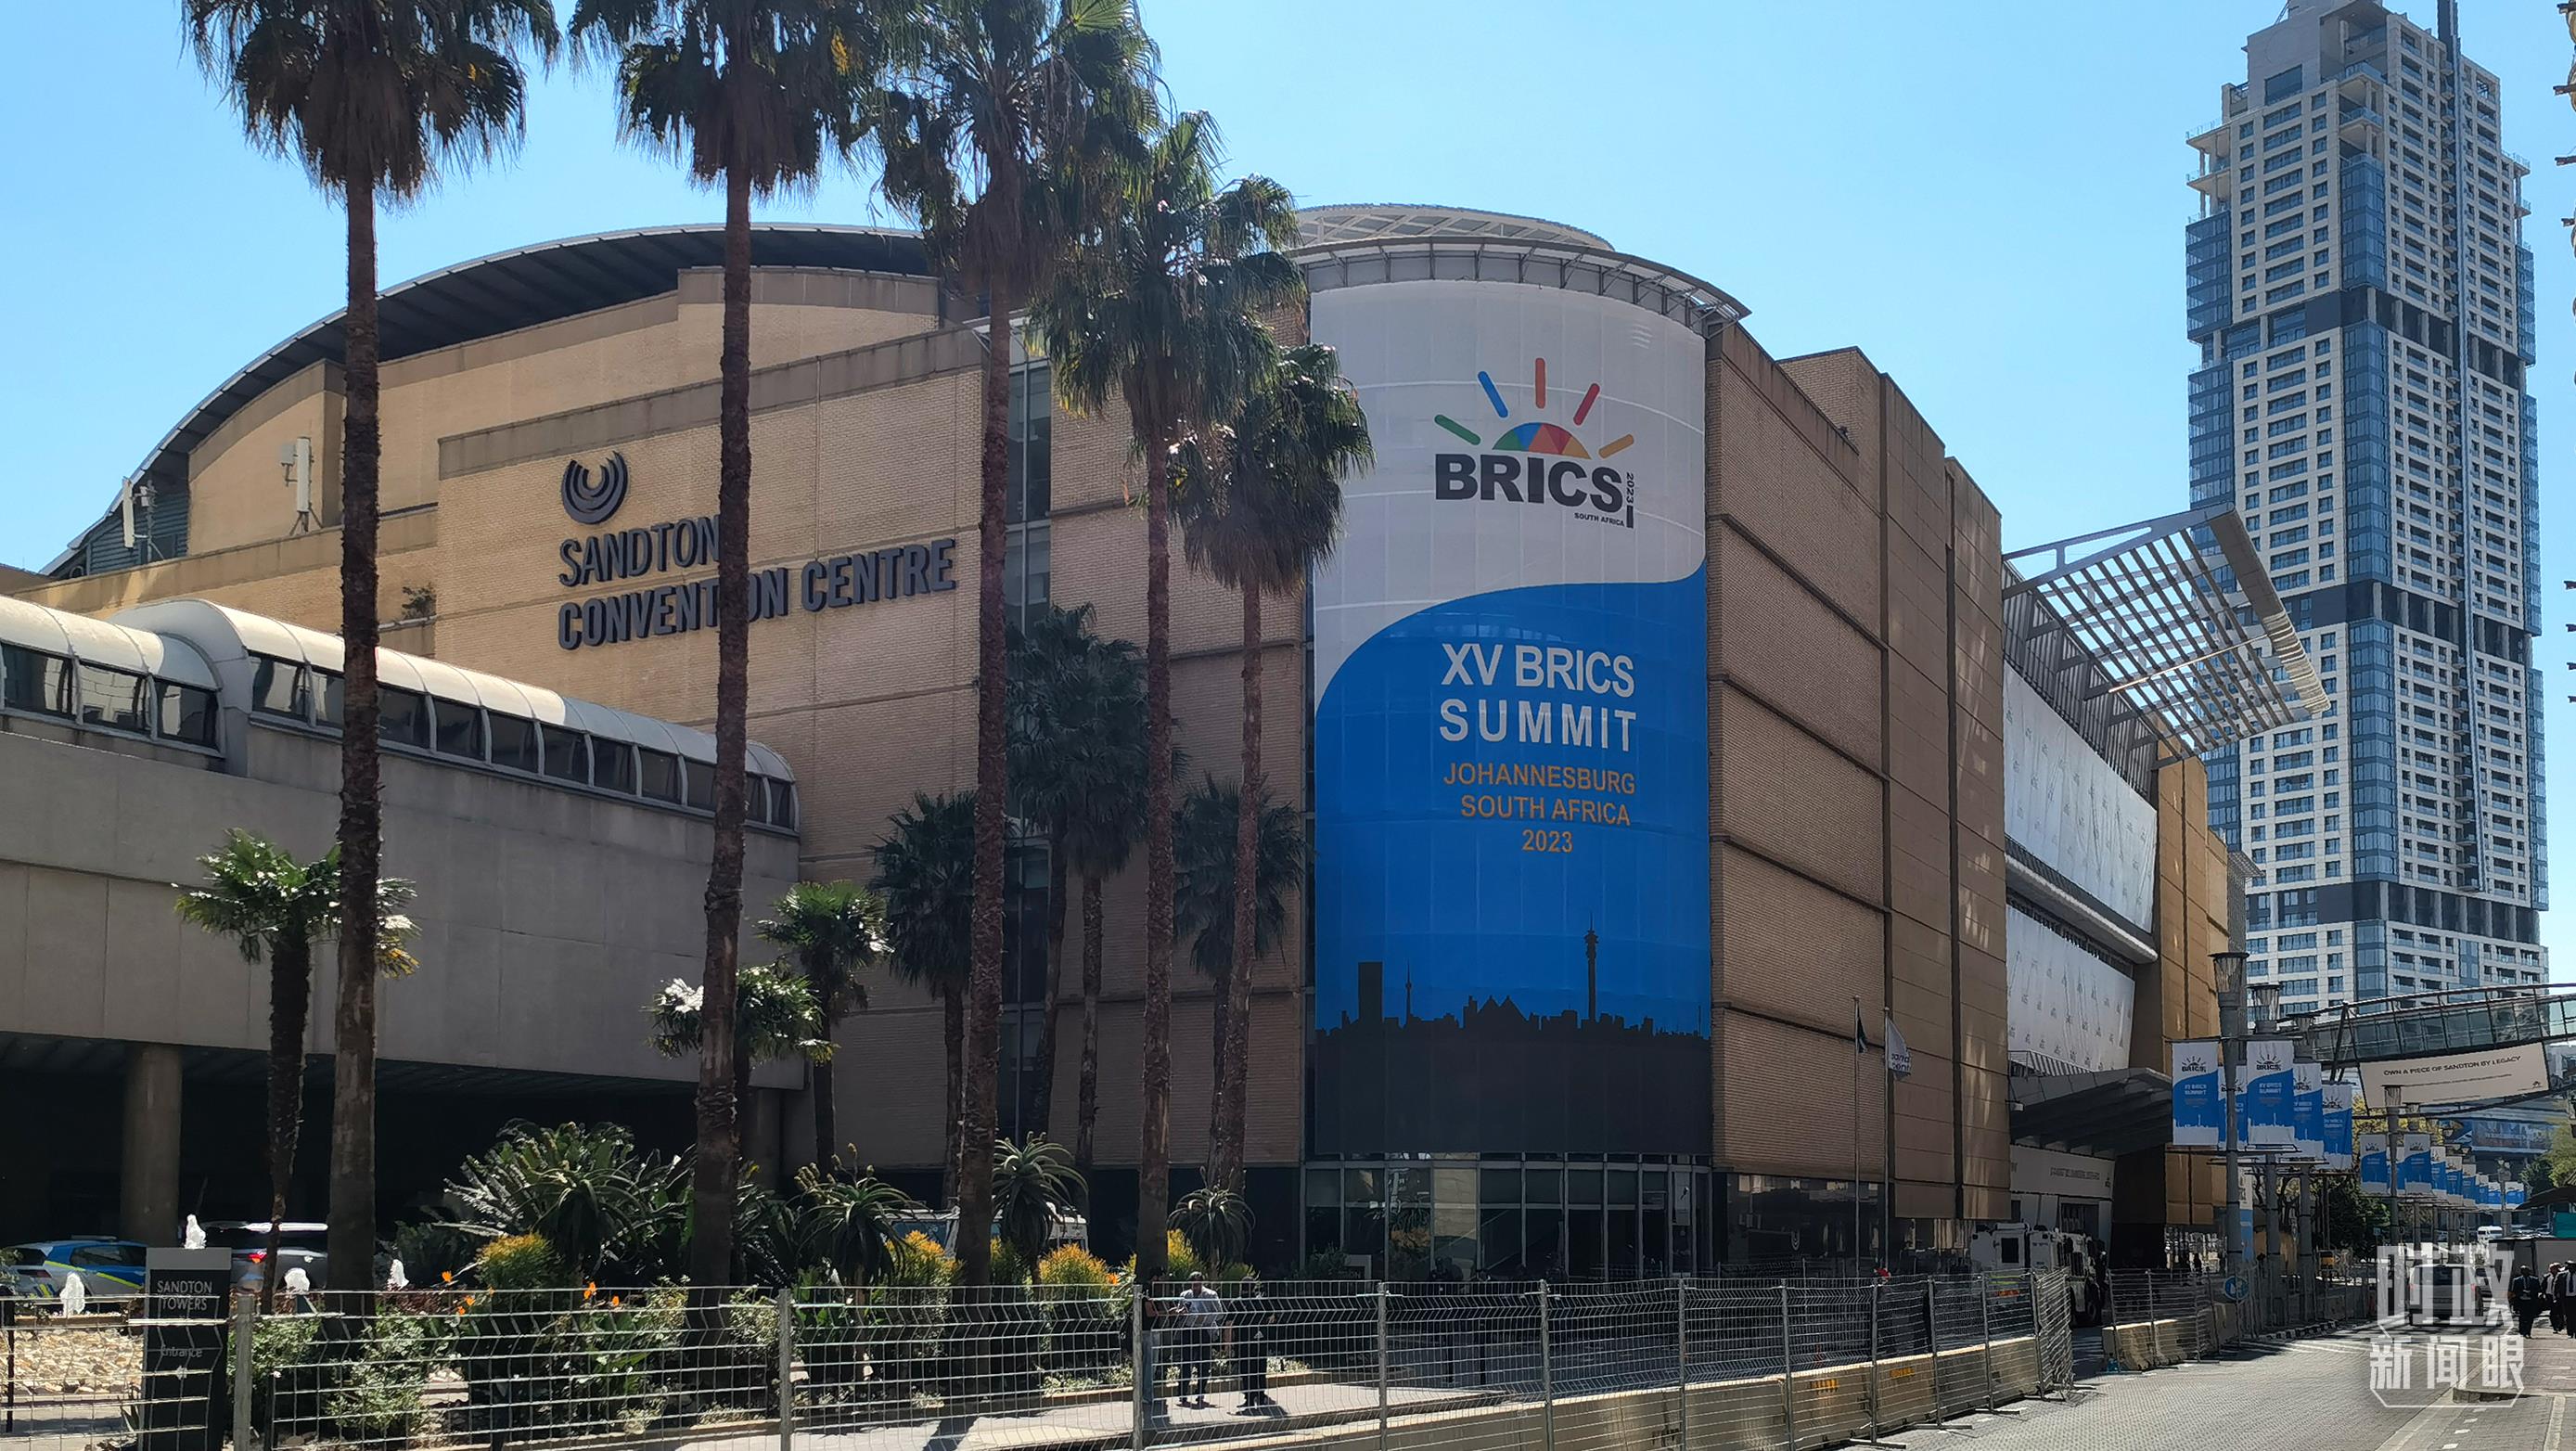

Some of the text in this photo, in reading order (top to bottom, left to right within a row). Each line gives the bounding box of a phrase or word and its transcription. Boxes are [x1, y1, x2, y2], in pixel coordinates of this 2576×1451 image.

[1435, 453, 1623, 513] BRICS
[1626, 471, 1634, 505] 2023
[1574, 512, 1625, 527] SOUTH AFRICA
[558, 513, 721, 587] SANDTON
[557, 537, 957, 650] CONVENTON CENTRE
[1440, 643, 1635, 698] XV BRICS
[1439, 698, 1636, 752] SUMMIT
[1443, 762, 1635, 795] JOHANNESBURG
[1460, 794, 1631, 826] SOUTH AFRICA
[1521, 829, 1573, 853] 2023
[2410, 1066, 2430, 1074] PIECE
[2443, 1061, 2480, 1072] SANDTON
[2492, 1055, 2521, 1065] LEGACY
[157, 1280, 212, 1293] SANDTON
[161, 1296, 207, 1311] TOWERS
